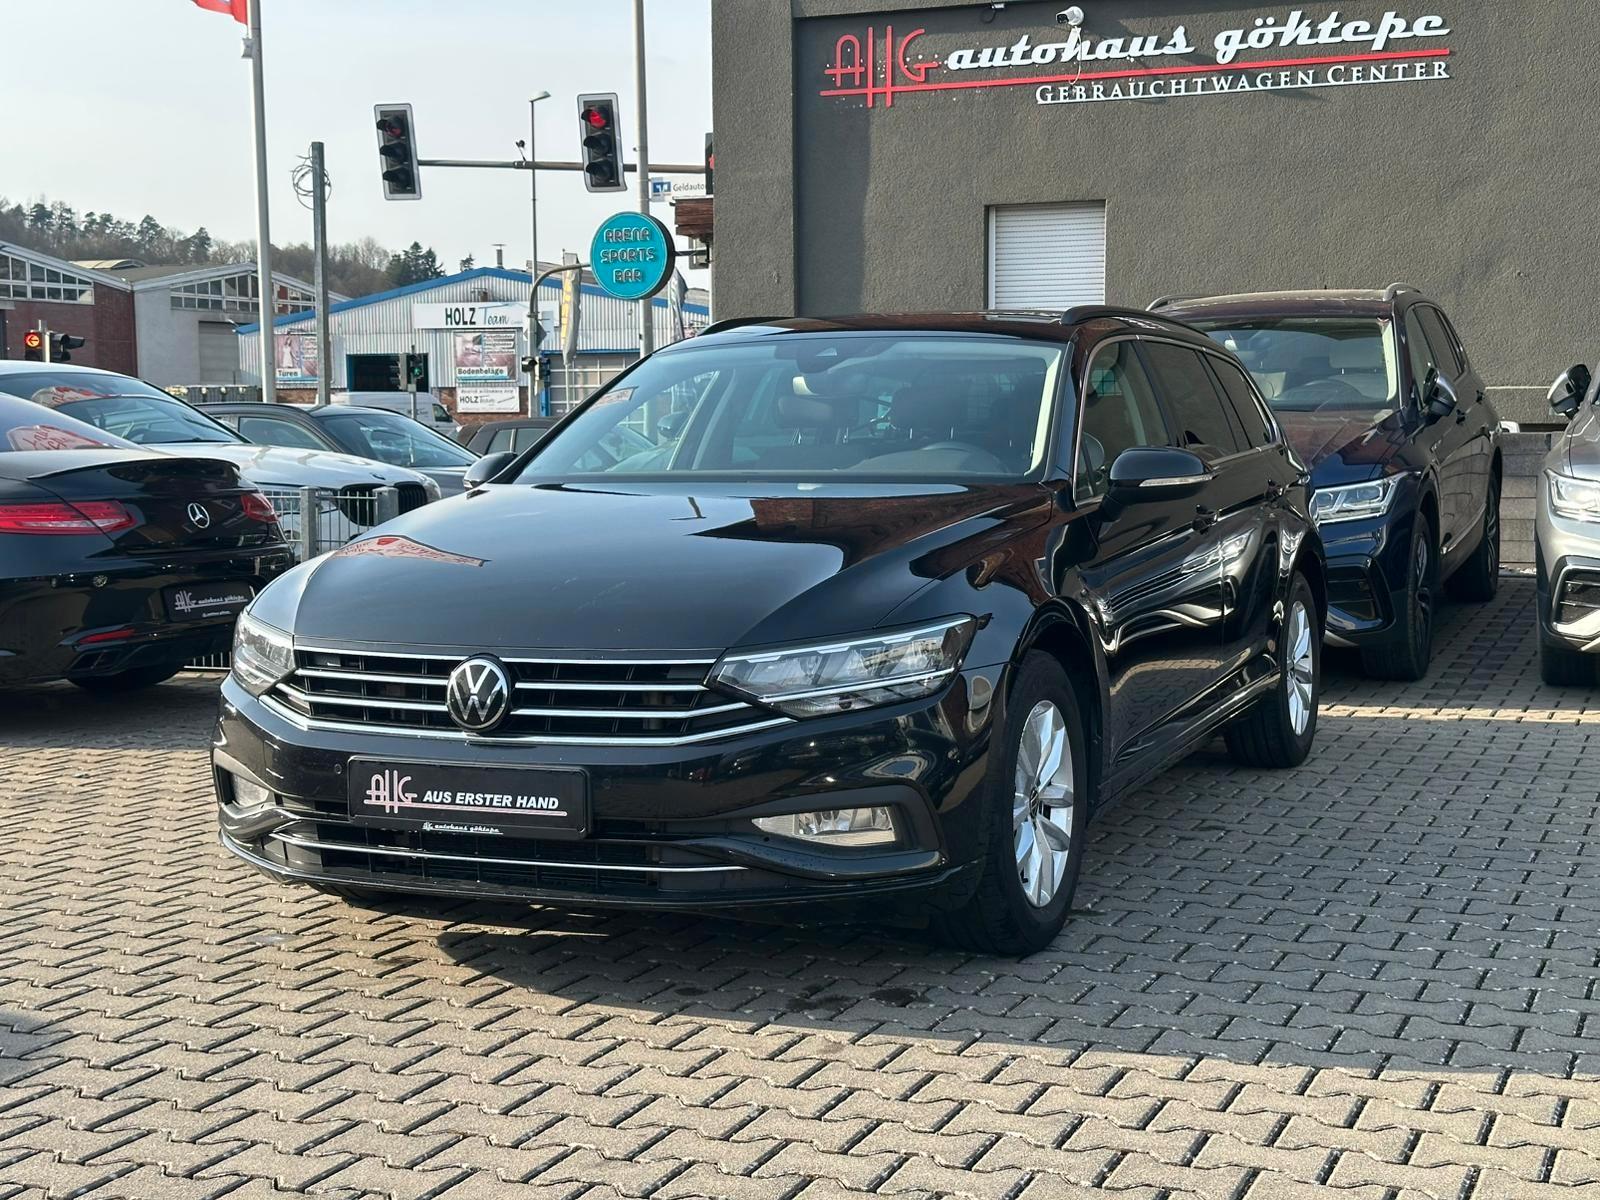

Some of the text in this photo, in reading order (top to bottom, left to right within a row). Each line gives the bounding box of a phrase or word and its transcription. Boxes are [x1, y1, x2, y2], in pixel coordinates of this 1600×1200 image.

[947, 24, 1195, 70] autohaus
[1213, 10, 1451, 64] göktepe
[1035, 60, 1451, 104] GEBRAUCHTWAGEN CENTER
[672, 182, 705, 192] Geldauto
[603, 227, 650, 243] ARENA
[600, 247, 655, 264] SPORTS
[612, 268, 643, 284] BAR
[445, 302, 510, 326] HOLZ Team
[459, 396, 479, 404] HOLZ
[365, 769, 560, 813] AHG AUS ERSTER HAND
